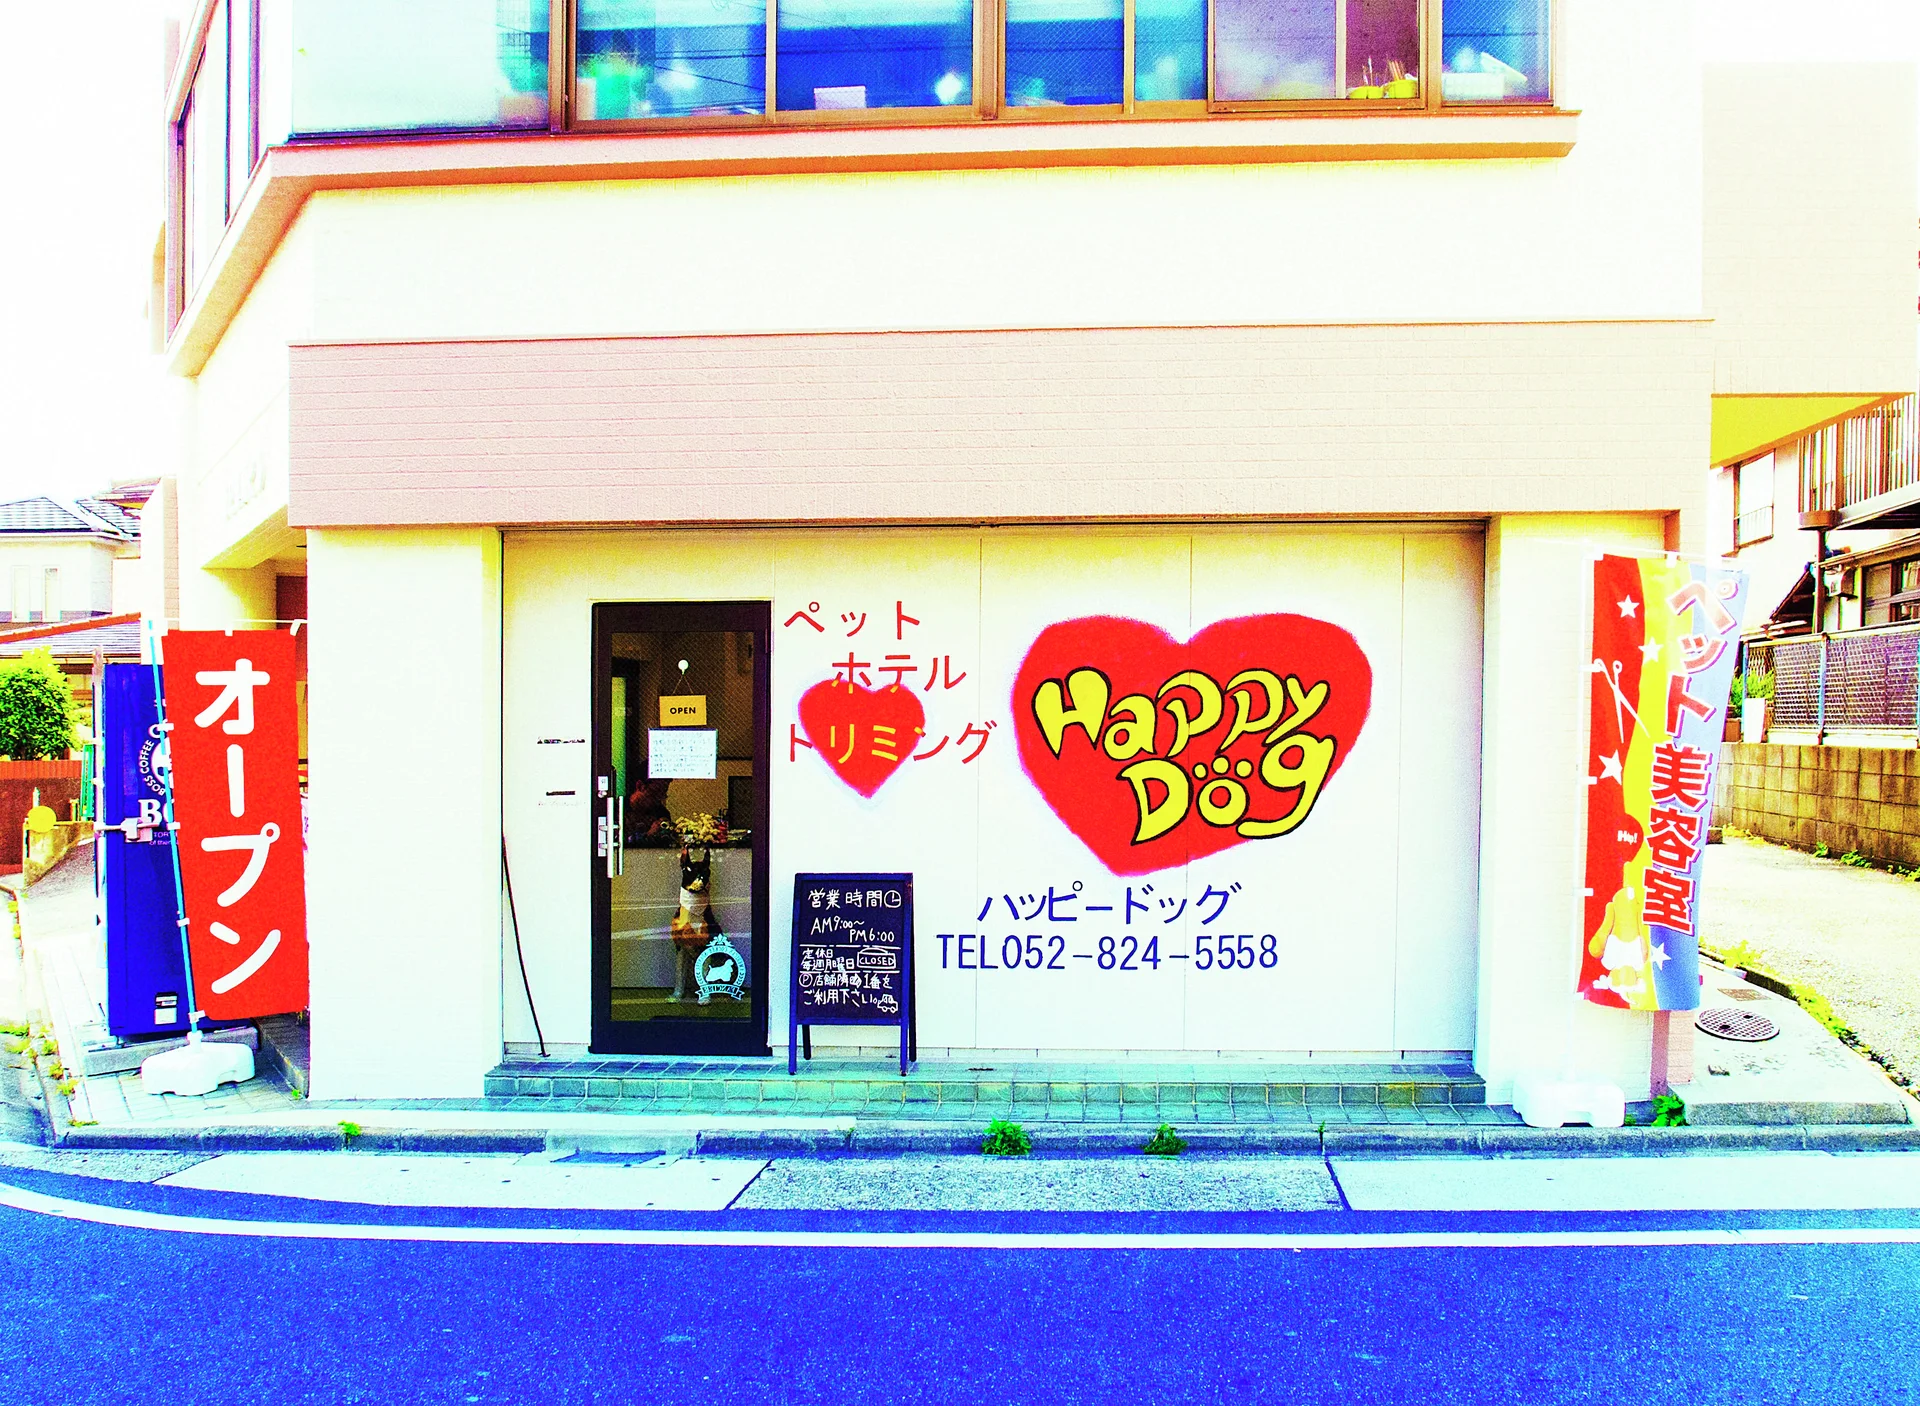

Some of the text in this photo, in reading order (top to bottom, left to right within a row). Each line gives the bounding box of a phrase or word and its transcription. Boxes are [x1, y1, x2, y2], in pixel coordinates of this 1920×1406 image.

[784, 601, 920, 640] ペット
[832, 652, 966, 694] ホテル
[669, 707, 697, 715] OPEN
[1031, 666, 1331, 760] Happy
[138, 739, 155, 774] COFFEE
[790, 720, 997, 765] トリミング
[1642, 578, 1739, 937] ペット美容室
[1115, 731, 1337, 846] Dog
[194, 658, 281, 994] オープン
[808, 887, 883, 911] 営業時間
[977, 880, 1243, 926] ハッピードッグ
[802, 948, 834, 959] 定休日
[859, 957, 895, 966] CLOSED
